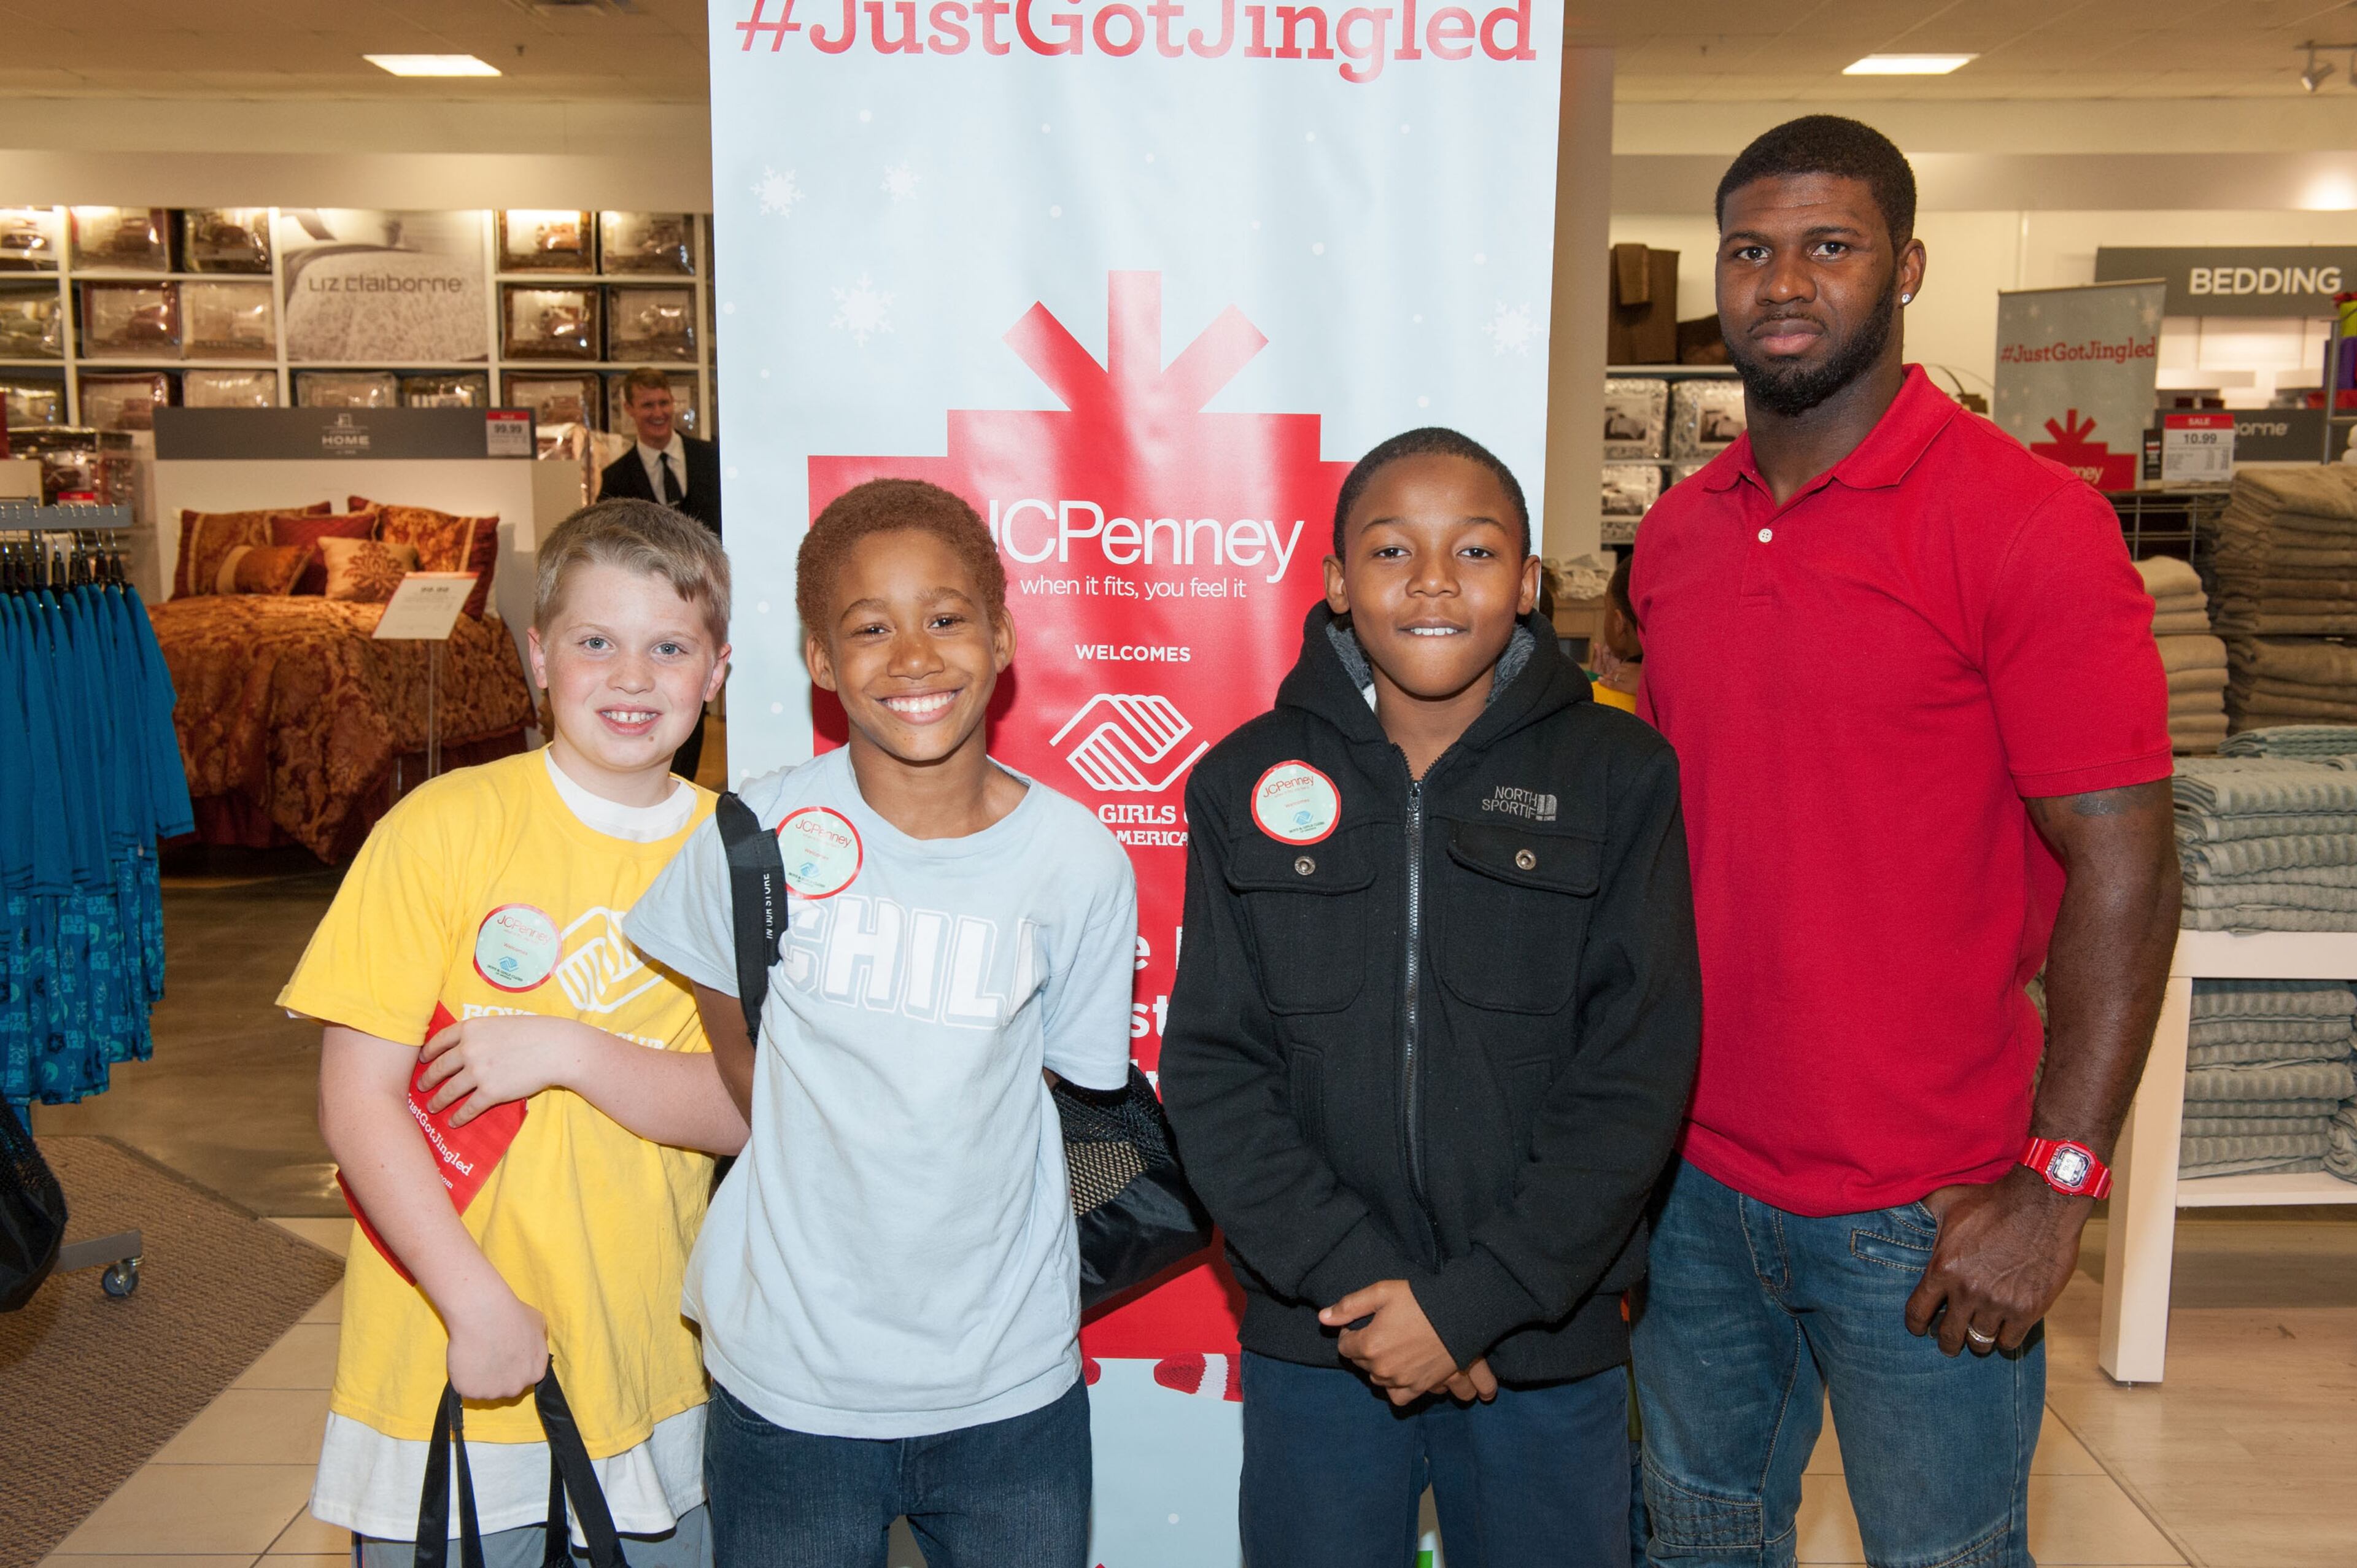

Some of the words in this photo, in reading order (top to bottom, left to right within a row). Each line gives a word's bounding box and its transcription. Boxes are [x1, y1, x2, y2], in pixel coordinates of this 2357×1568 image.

[736, 0, 1537, 84] #JustGotJingled
[2189, 266, 2342, 295] BEDDING
[2000, 336, 2157, 364] #JustGotJingled
[2188, 417, 2211, 426] SALE
[2234, 422, 2288, 437] orne
[322, 435, 370, 446] HOME
[2183, 433, 2218, 444] 10.99
[1020, 575, 1080, 595] when
[1086, 576, 1099, 595] it
[1104, 576, 1139, 600] fits,
[1144, 581, 1184, 601] you
[1190, 577, 1227, 598] feel
[1233, 578, 1247, 598] it
[1074, 644, 1191, 662] WELCOMES
[1263, 776, 1314, 798] JCPenney
[1494, 786, 1538, 806] NORTH
[1097, 804, 1177, 825] GIRLS
[1482, 798, 1537, 819] SPORTIF
